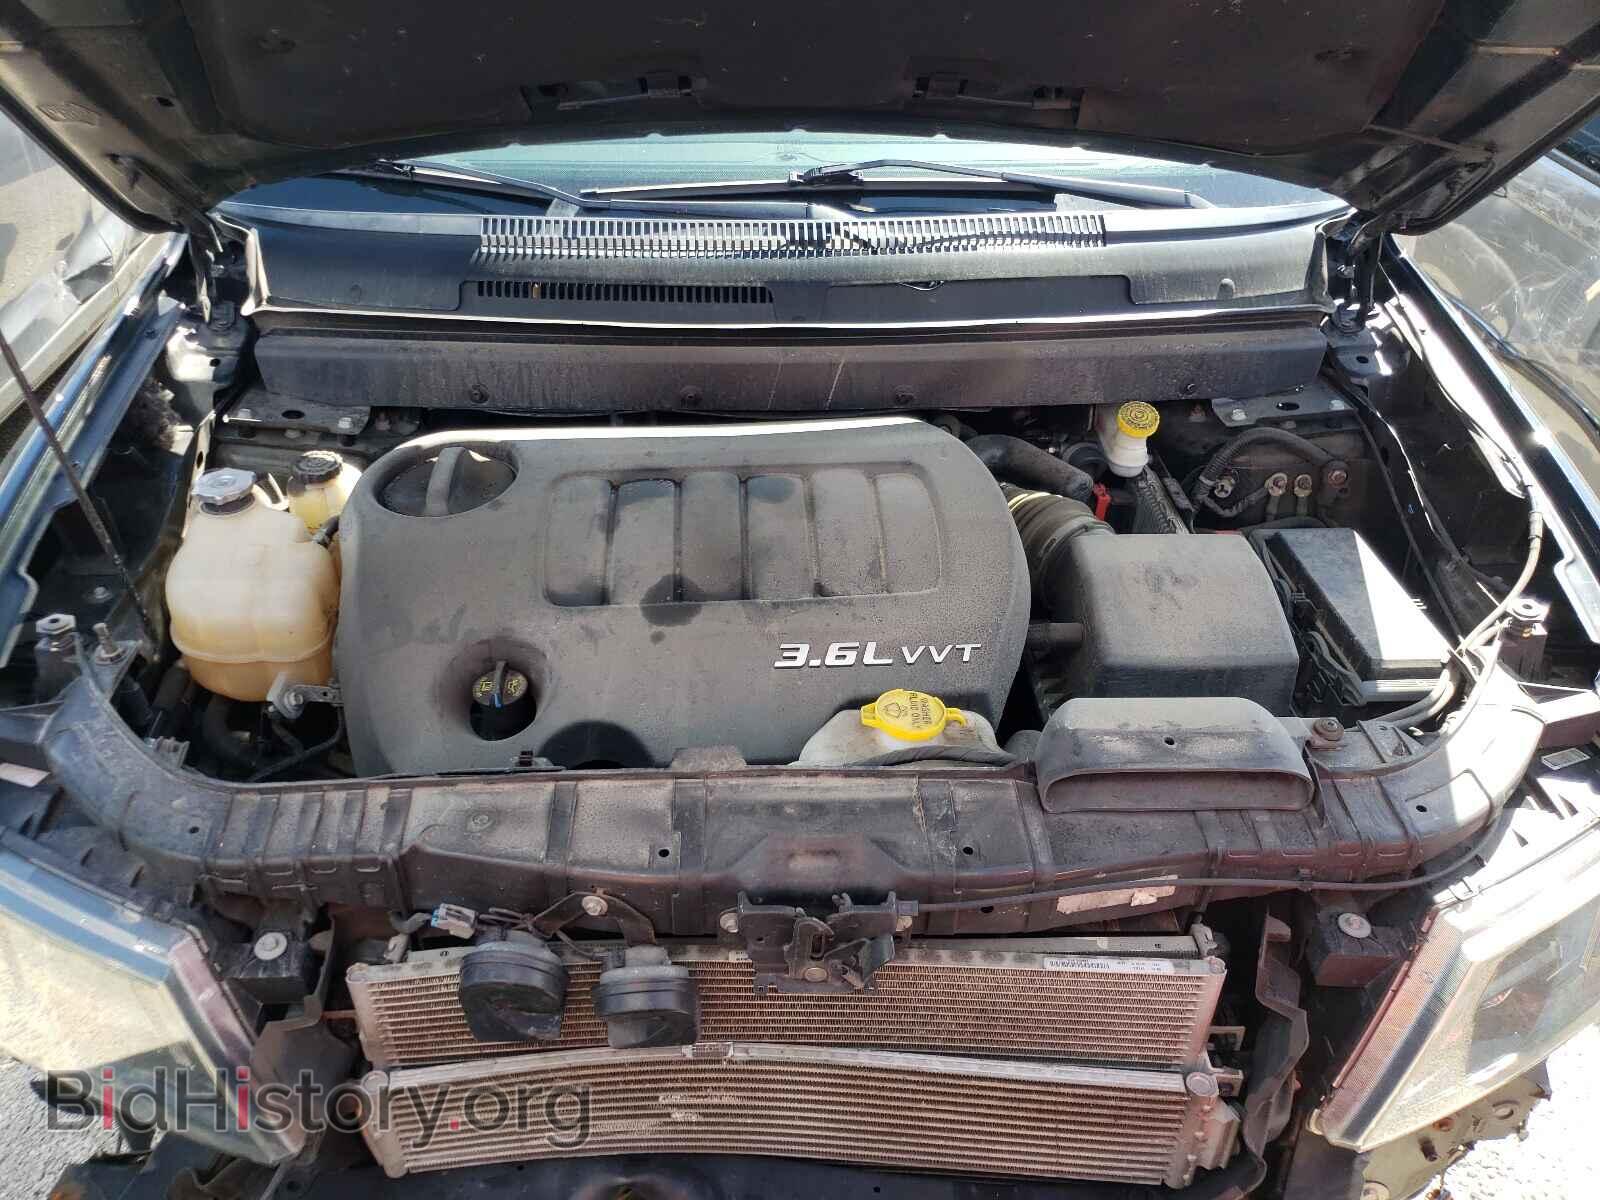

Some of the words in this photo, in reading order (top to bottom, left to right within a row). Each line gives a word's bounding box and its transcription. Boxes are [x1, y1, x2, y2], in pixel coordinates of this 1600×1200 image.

[774, 641, 893, 669] 3.6L
[901, 643, 982, 664] VVT
[910, 692, 919, 710] FLUID
[920, 698, 931, 725] WASHER
